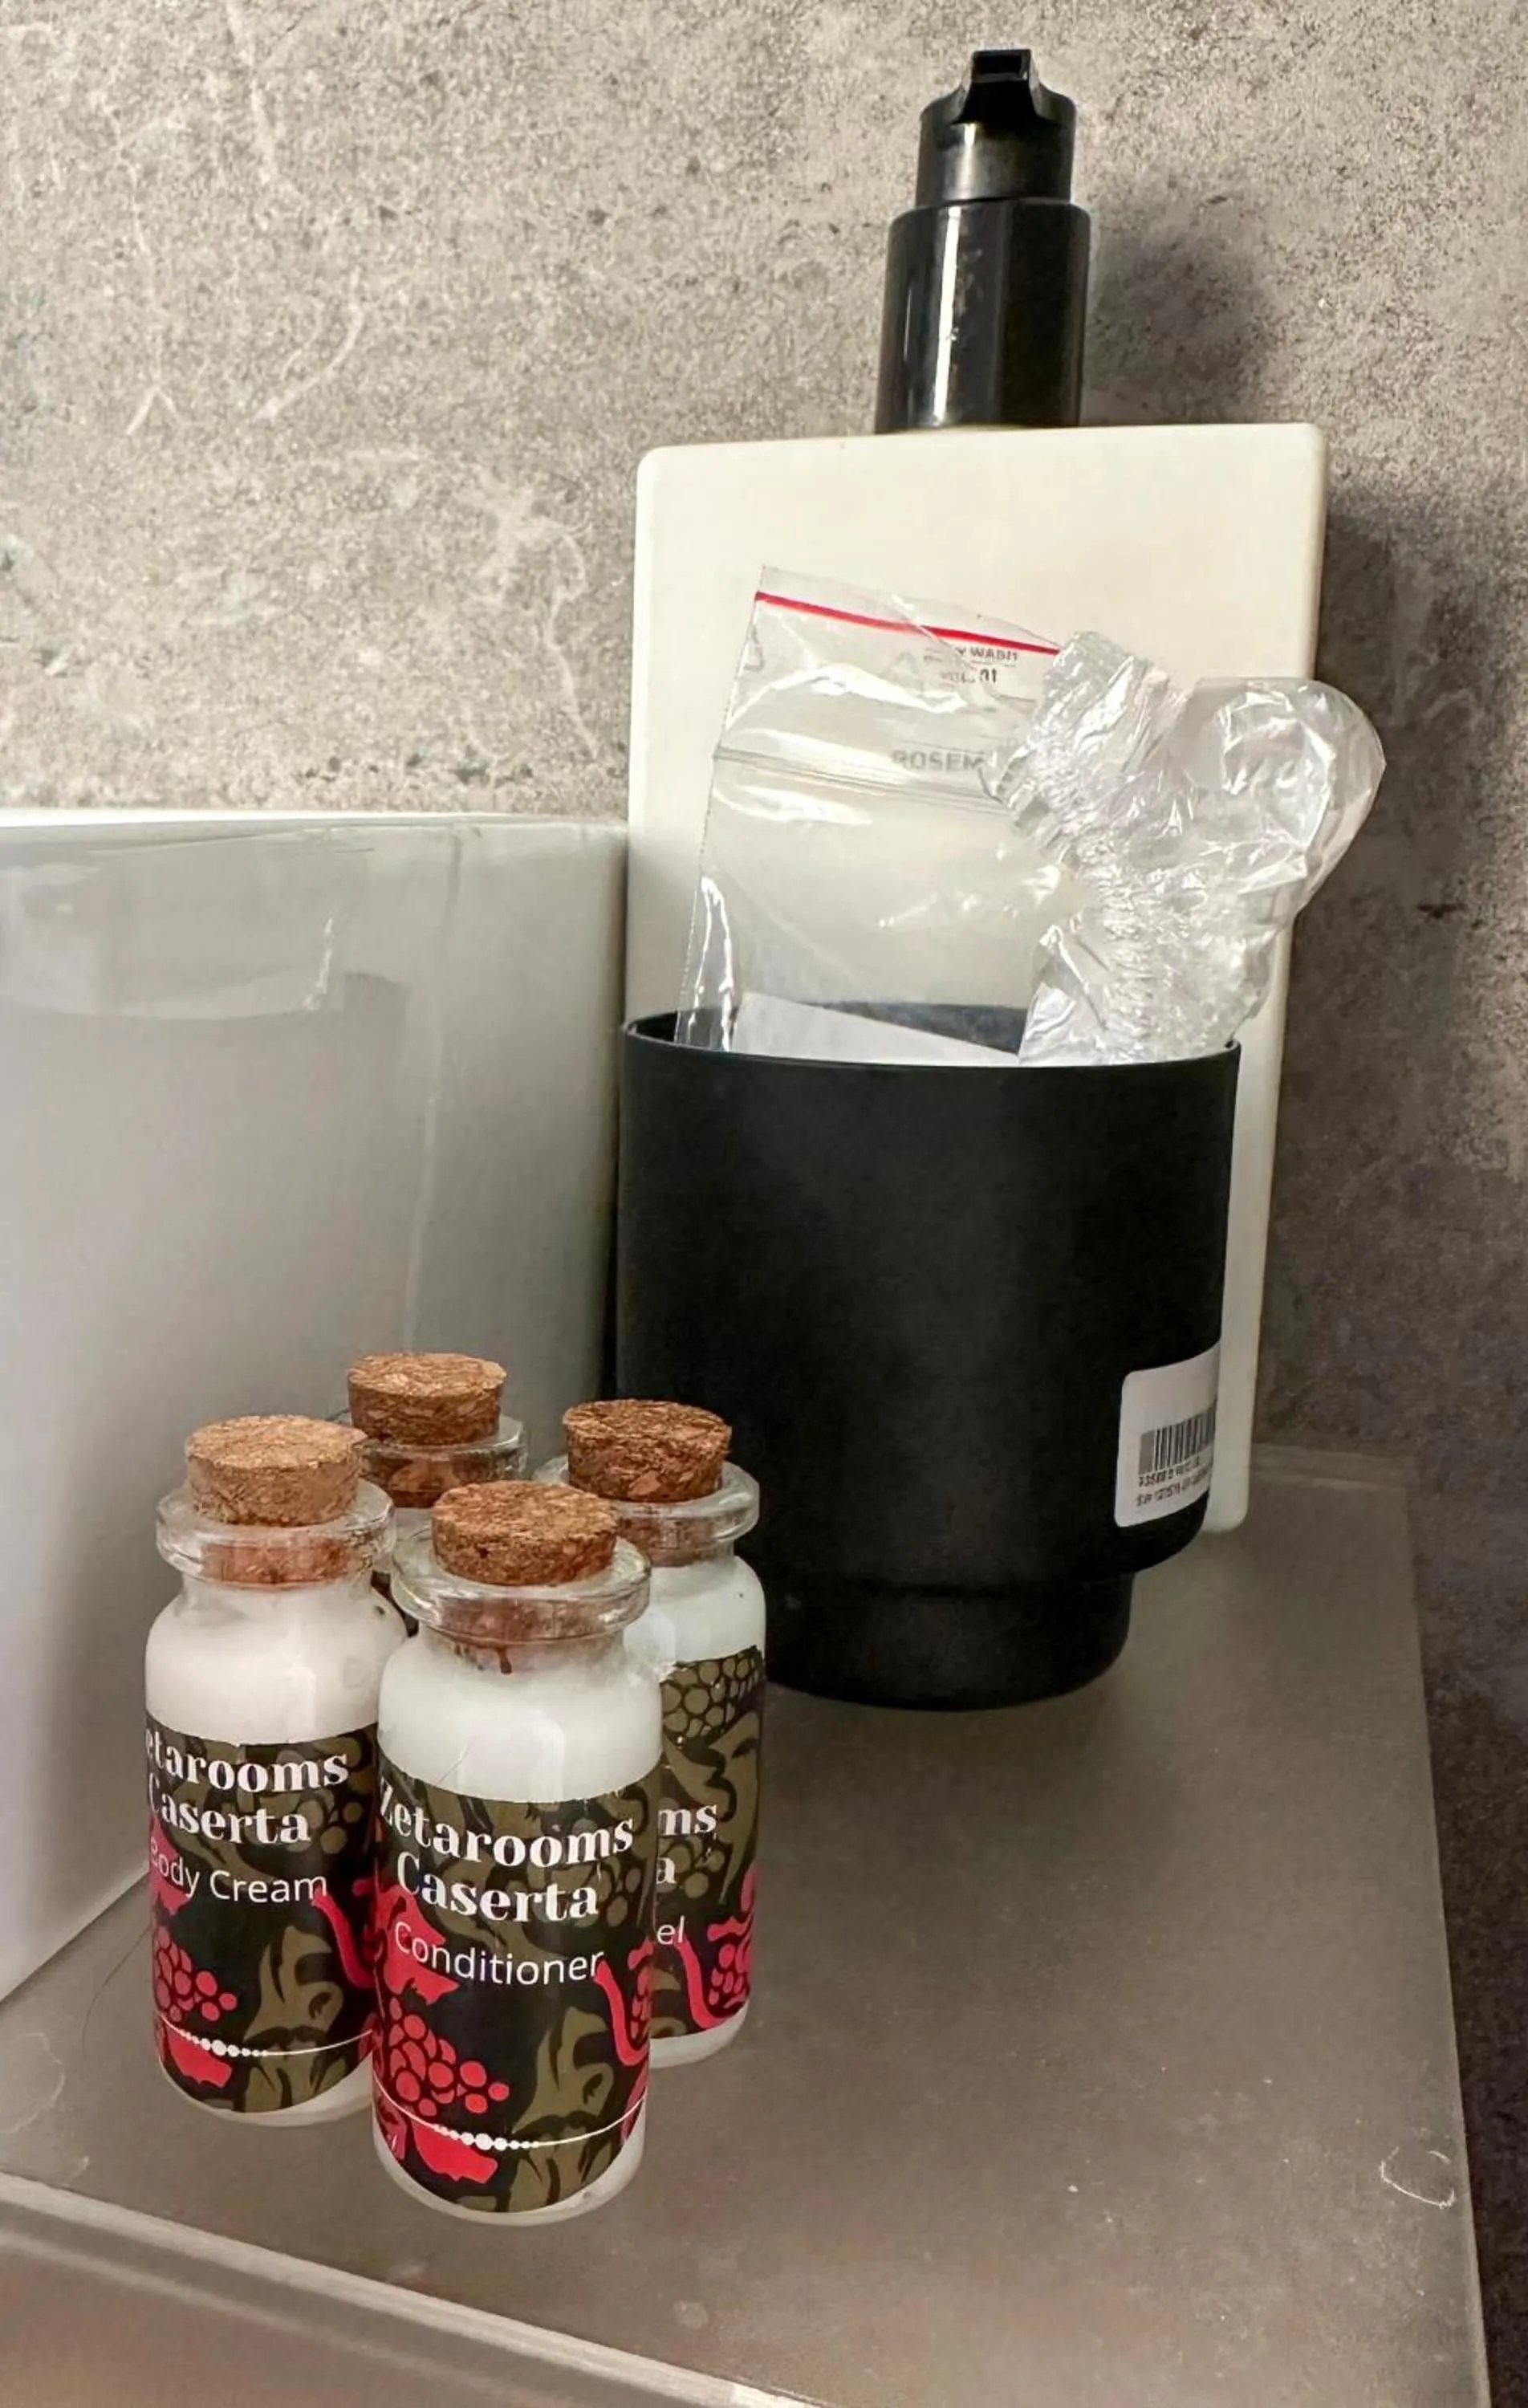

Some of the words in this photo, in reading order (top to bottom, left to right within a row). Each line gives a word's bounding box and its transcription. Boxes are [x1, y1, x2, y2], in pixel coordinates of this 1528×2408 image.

[148, 1771, 311, 1845] Caserta
[380, 1775, 634, 1868] Zetarooms
[209, 1869, 327, 1903] Cream
[397, 1852, 599, 1923] Caserta
[394, 1922, 604, 1986] Conditioner
